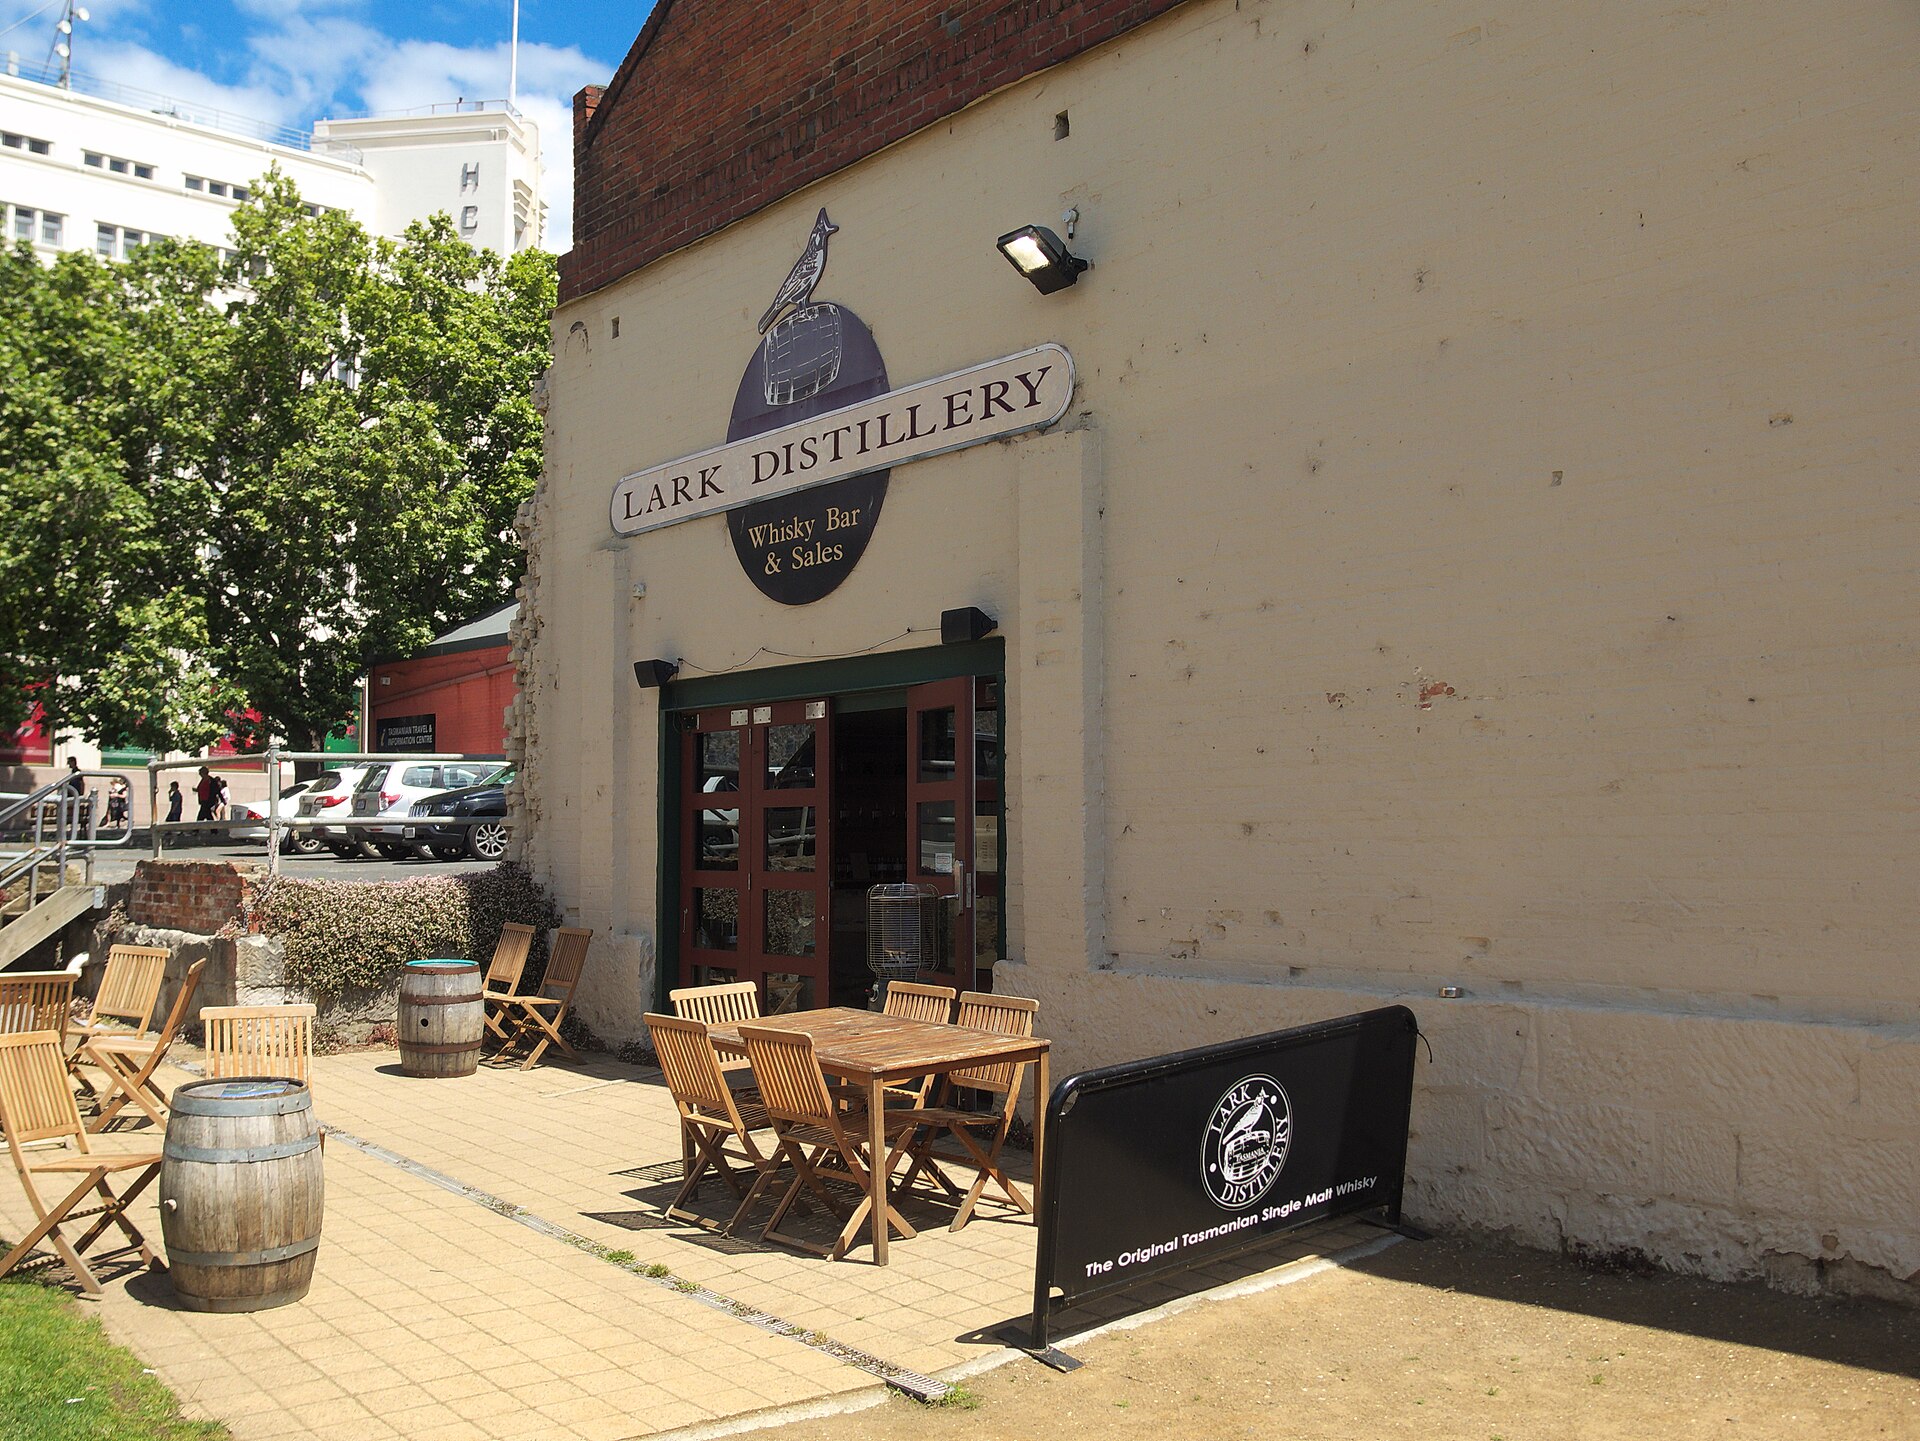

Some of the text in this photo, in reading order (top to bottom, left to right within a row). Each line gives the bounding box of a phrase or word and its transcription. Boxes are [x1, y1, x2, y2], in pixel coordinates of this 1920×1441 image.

[623, 365, 1052, 520] LARK DISTILLERY
[748, 507, 860, 549] Whisky Bar
[764, 543, 844, 576] & Sales
[387, 734, 433, 746] INFORMATION CENTRE
[412, 725, 428, 734] TRAVEL
[1211, 1084, 1251, 1133] LARK
[1220, 1114, 1288, 1203] DISTILLERY
[1235, 1146, 1265, 1163] TASMANIA
[1085, 1174, 1377, 1278] The Original Tasmanian Single Malt Whisky
